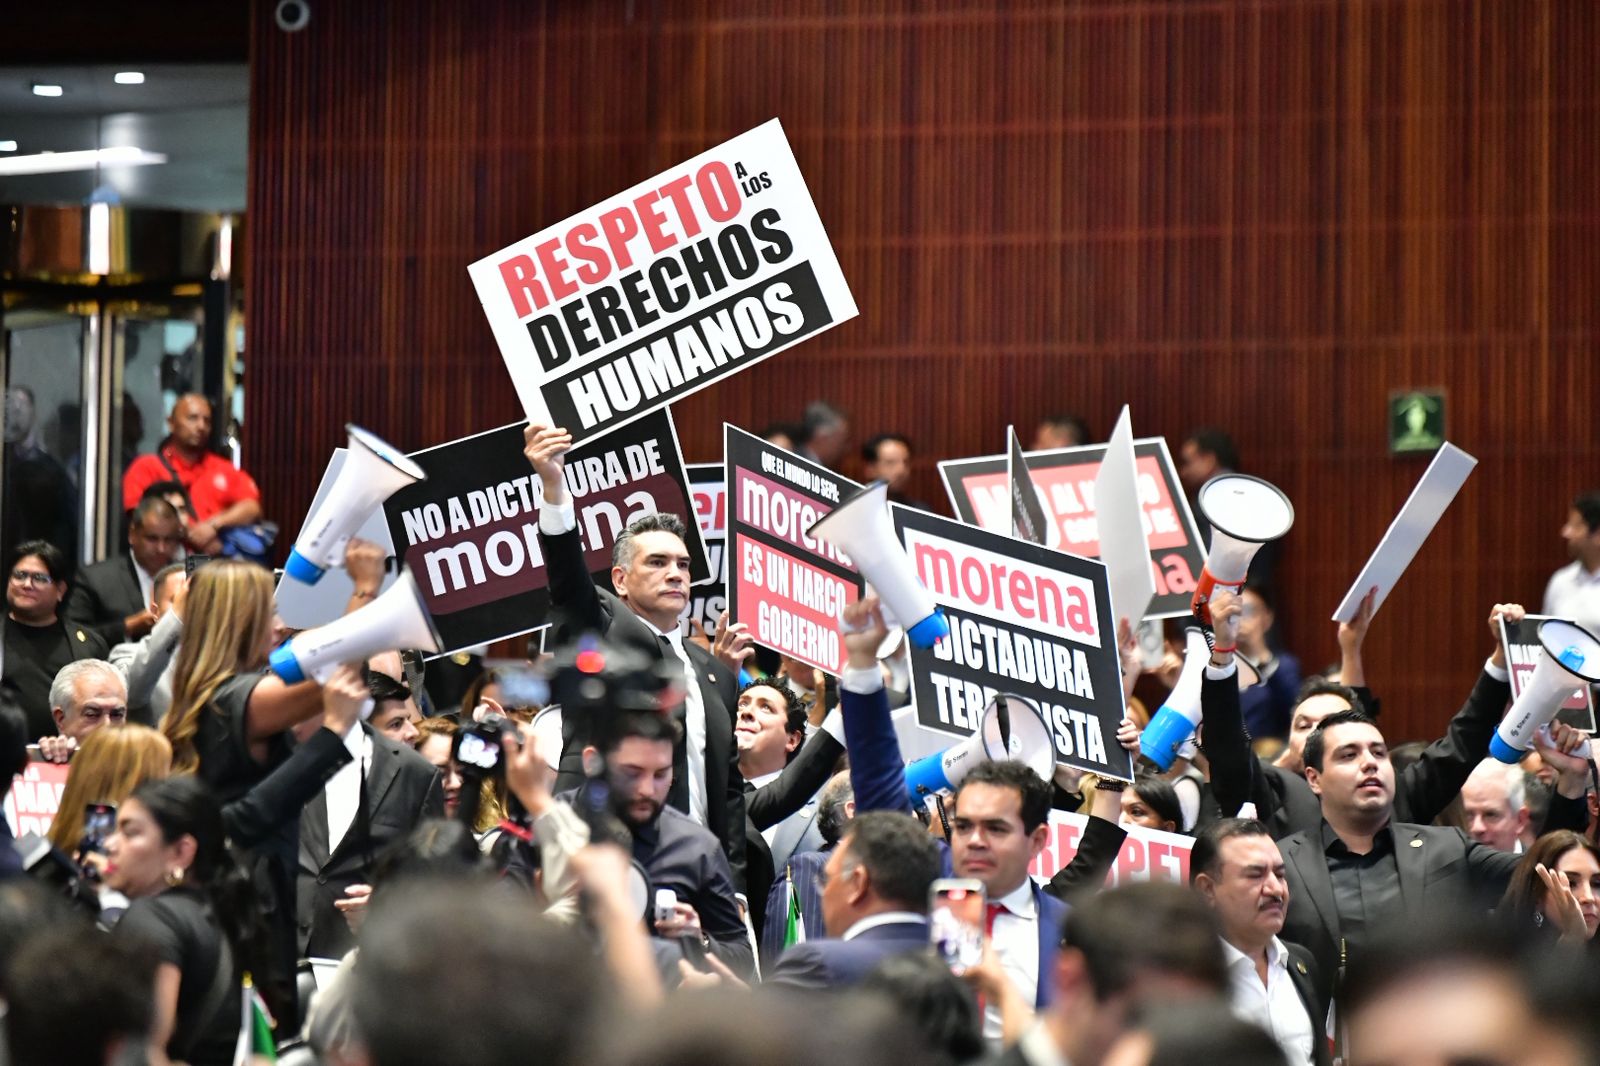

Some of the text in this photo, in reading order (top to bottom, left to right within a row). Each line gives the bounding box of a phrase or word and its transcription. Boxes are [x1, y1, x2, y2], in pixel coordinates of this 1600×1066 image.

[734, 162, 748, 179] A
[741, 171, 772, 198] LOS
[498, 160, 742, 319] RESPETO
[526, 208, 794, 373] DERECHOS
[566, 281, 805, 430] HUMANOS
[401, 502, 446, 546] NO
[447, 497, 468, 534] A
[623, 440, 666, 481] DE
[761, 450, 776, 474] QUE
[776, 457, 785, 478] EL
[785, 461, 811, 490] MUNDO
[811, 473, 820, 494] LO
[743, 541, 763, 587] ES
[766, 551, 789, 598] UN
[792, 561, 847, 621] NARCO
[914, 541, 1095, 636] morena
[758, 600, 840, 671] GOBIERNO
